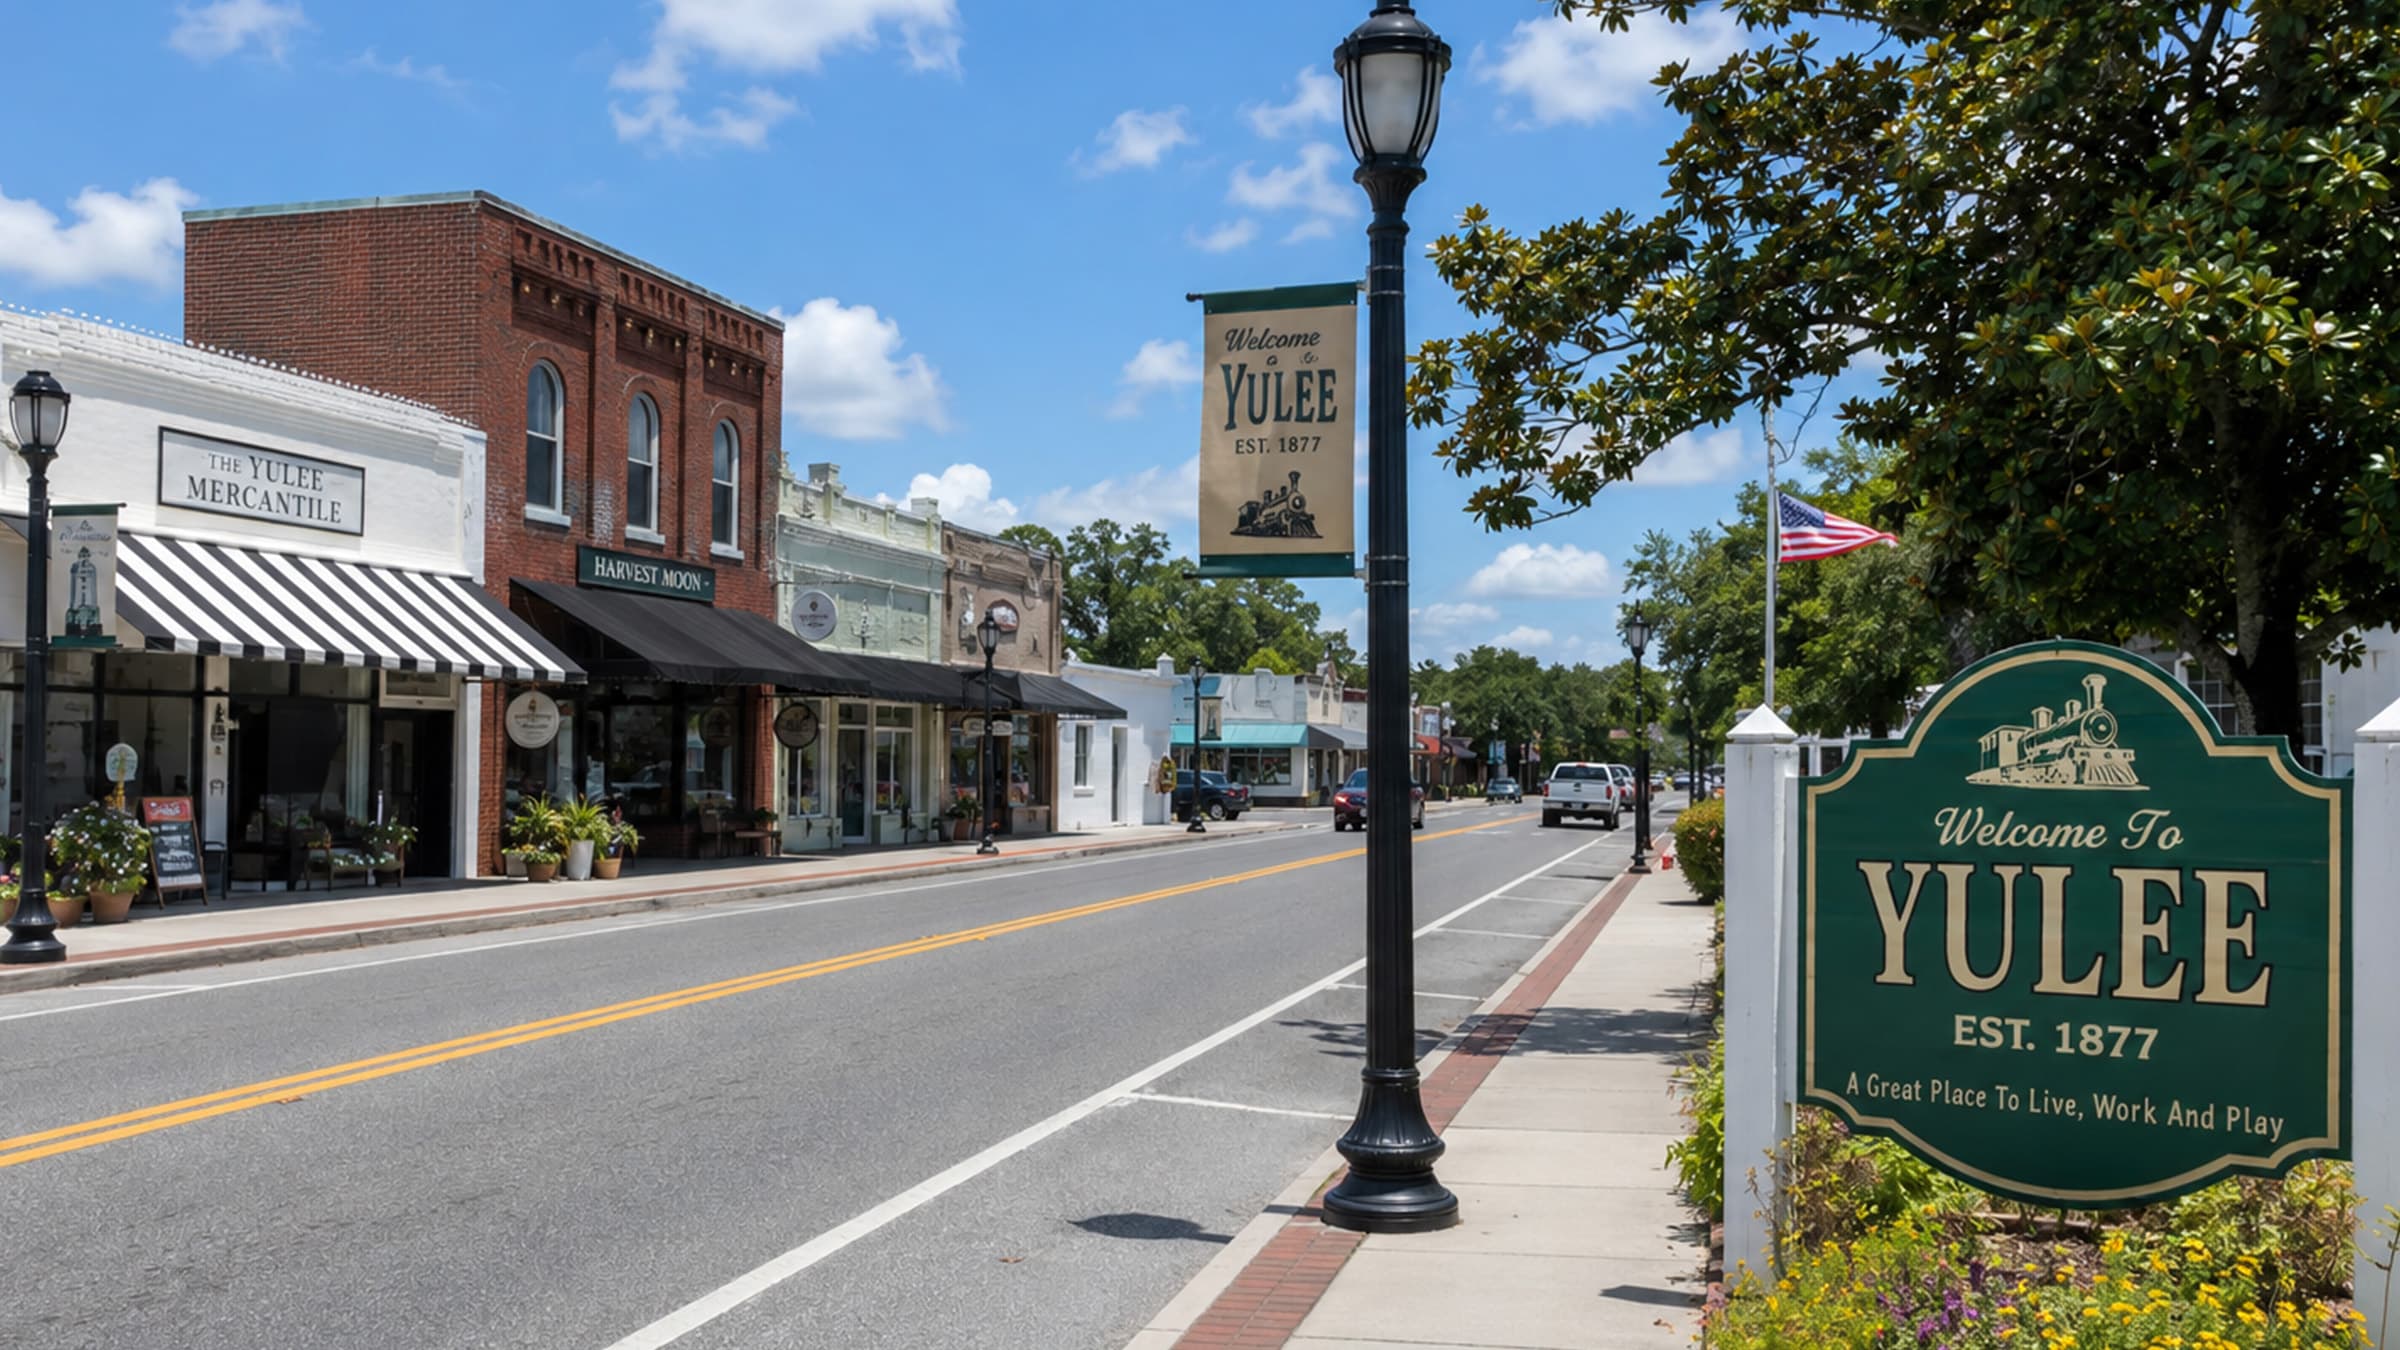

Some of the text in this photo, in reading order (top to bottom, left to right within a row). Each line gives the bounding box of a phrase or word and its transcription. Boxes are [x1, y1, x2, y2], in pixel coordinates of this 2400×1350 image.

[1225, 327, 1321, 353] Welcome
[1220, 362, 1338, 431] YULEE
[1235, 436, 1322, 455] EST. 1877
[207, 453, 324, 493] THE YULEE
[187, 474, 342, 524] MERCANTILE
[594, 555, 701, 591] HARVEST MOON
[1934, 806, 2185, 851] Welcome To
[1857, 859, 2272, 1008] YULEE
[1953, 1014, 2160, 1061] EST. 1877
[1846, 1071, 2285, 1143] A Great Place To Live, Work And Play
